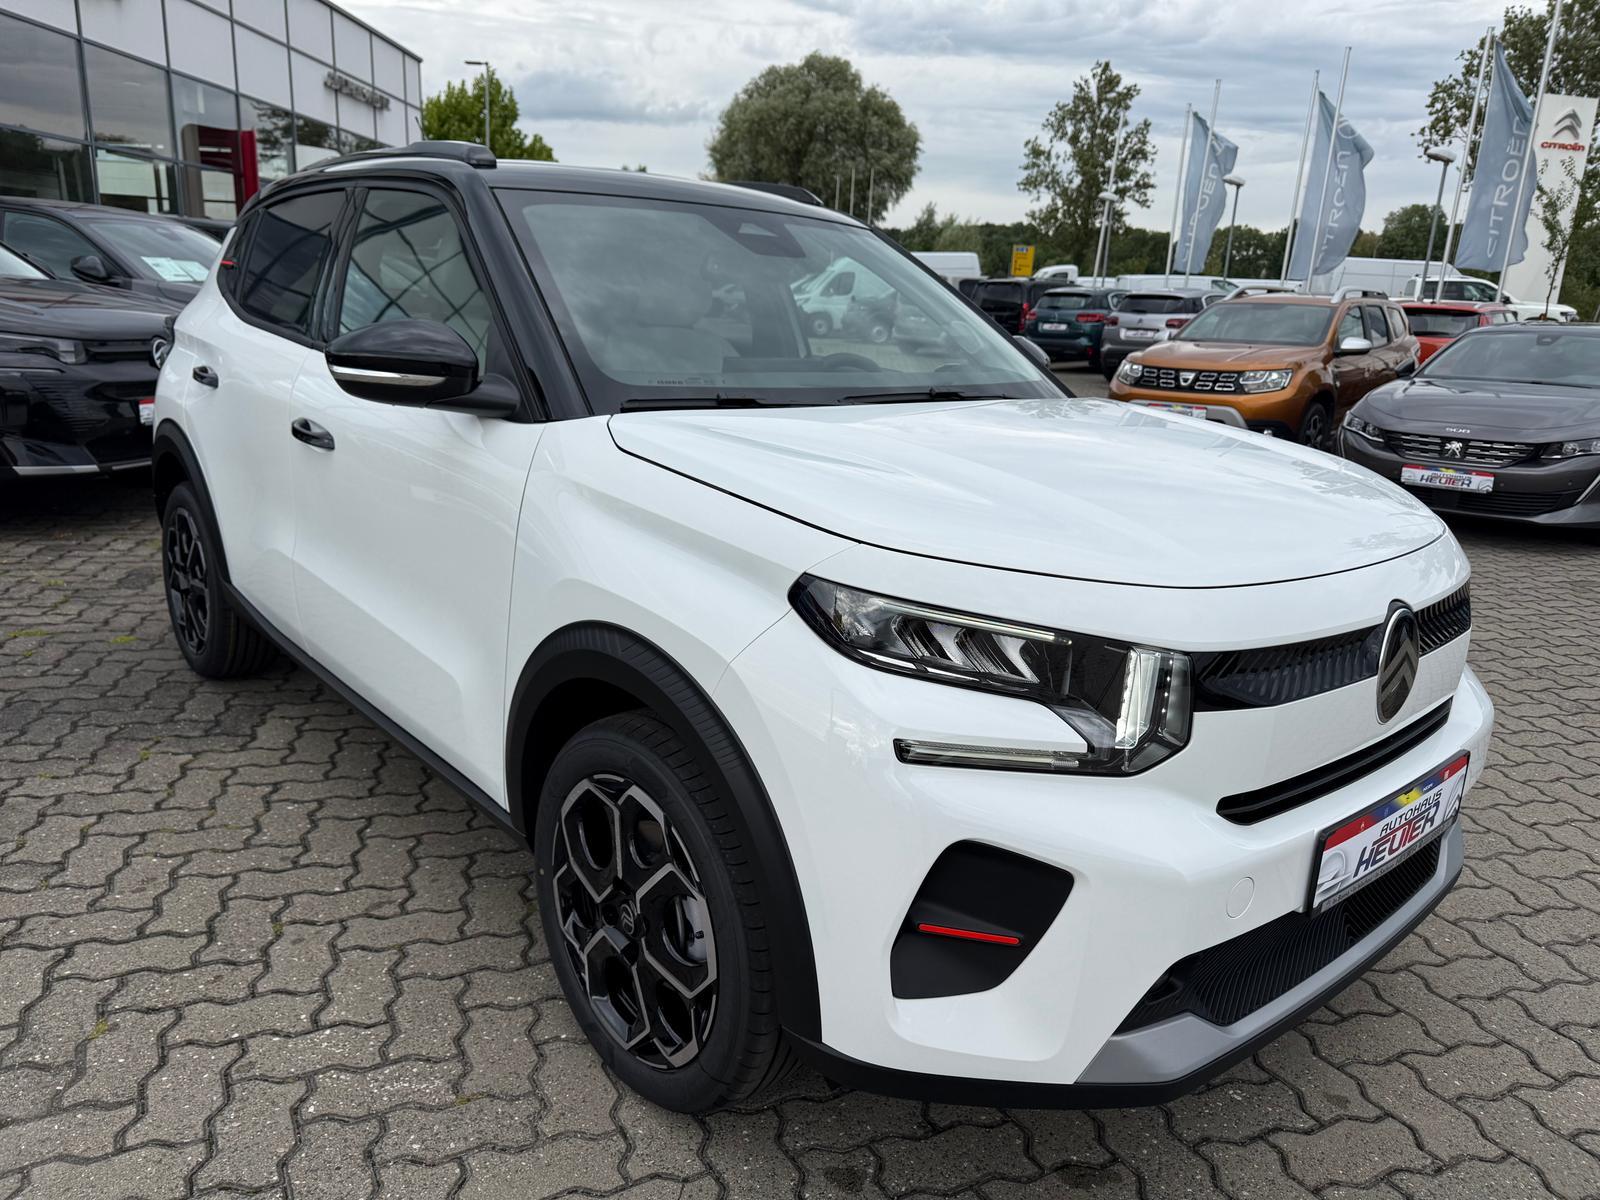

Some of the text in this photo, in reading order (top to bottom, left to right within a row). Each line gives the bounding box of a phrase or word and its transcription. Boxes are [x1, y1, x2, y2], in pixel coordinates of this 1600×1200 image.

[1420, 474, 1472, 487] HEUTER
[1380, 788, 1443, 836] AUTOHAUS
[1353, 801, 1440, 878] HEUTER
